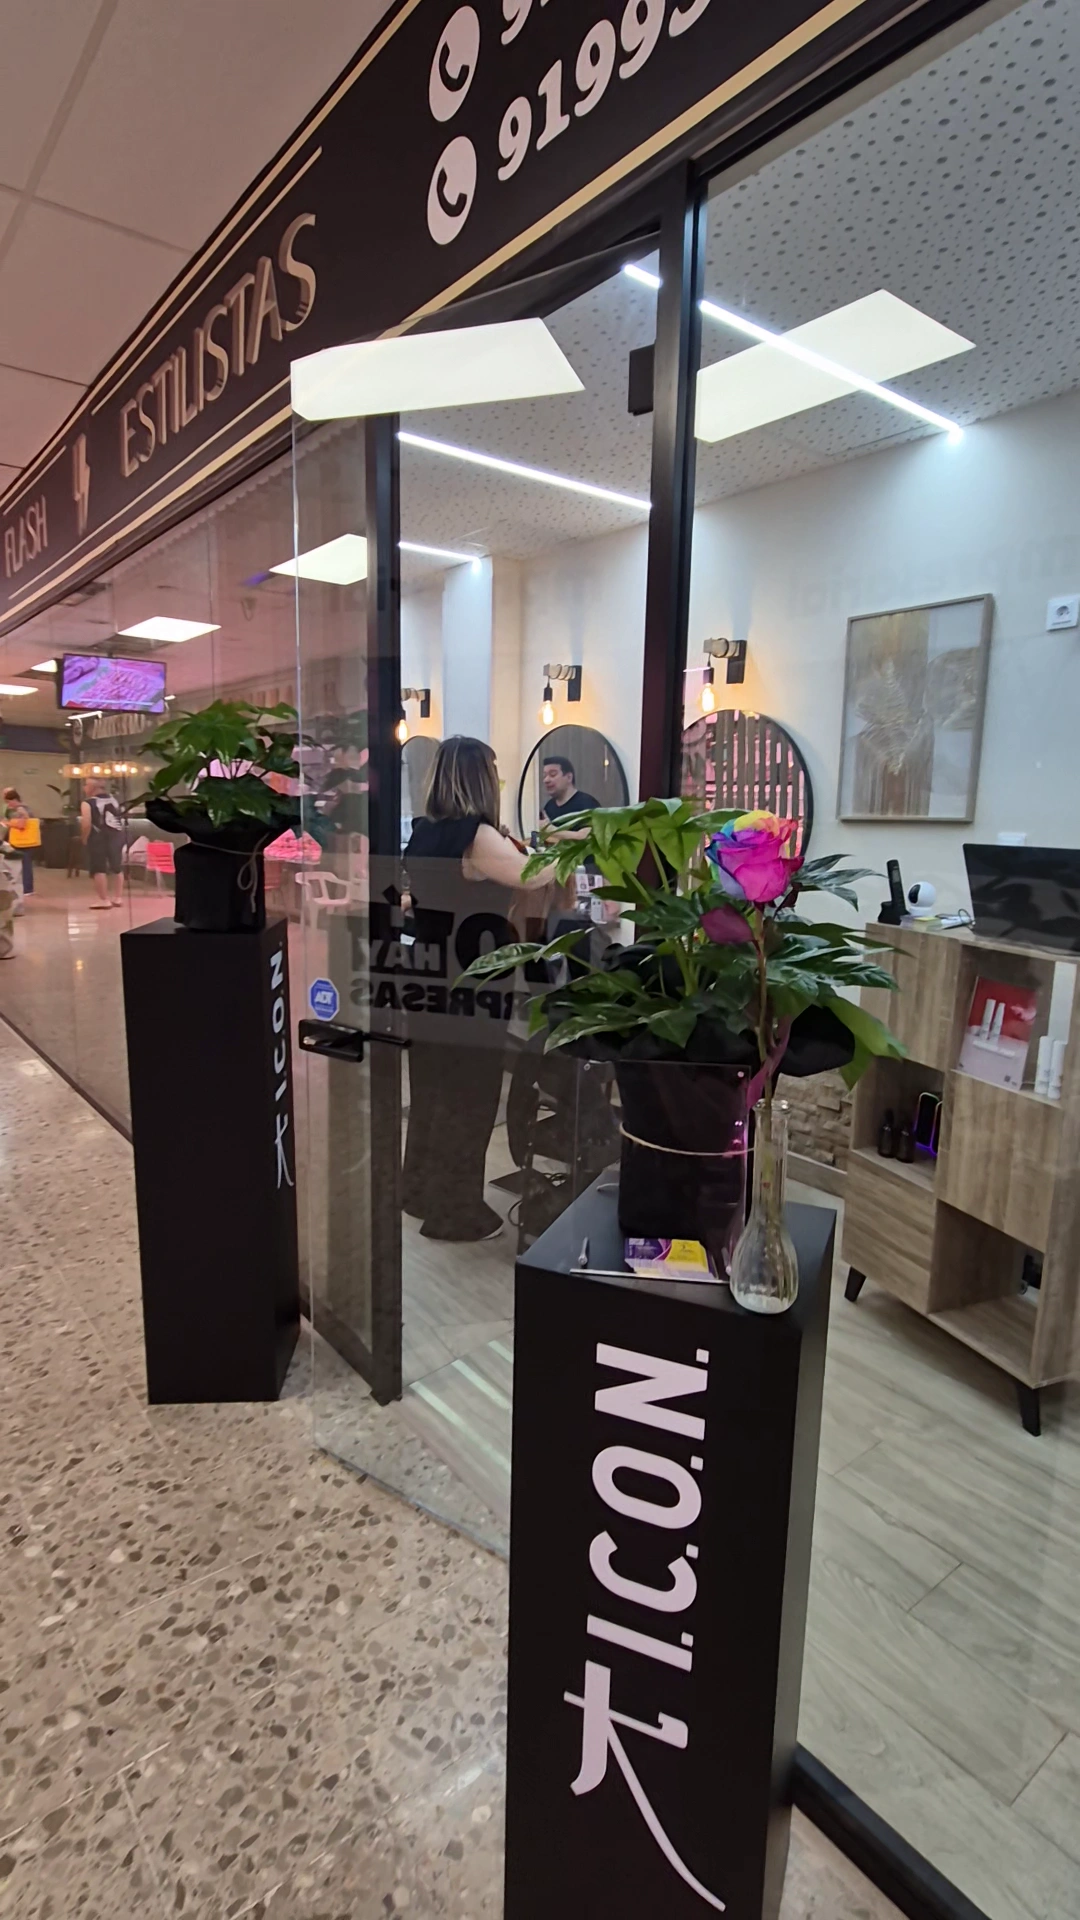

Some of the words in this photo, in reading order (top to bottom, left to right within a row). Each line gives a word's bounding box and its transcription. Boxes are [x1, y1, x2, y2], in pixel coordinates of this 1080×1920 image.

[5, 494, 48, 578] FLASH
[120, 212, 317, 478] ESTILISTAS
[586, 1343, 710, 1672] I.C.O.N.
